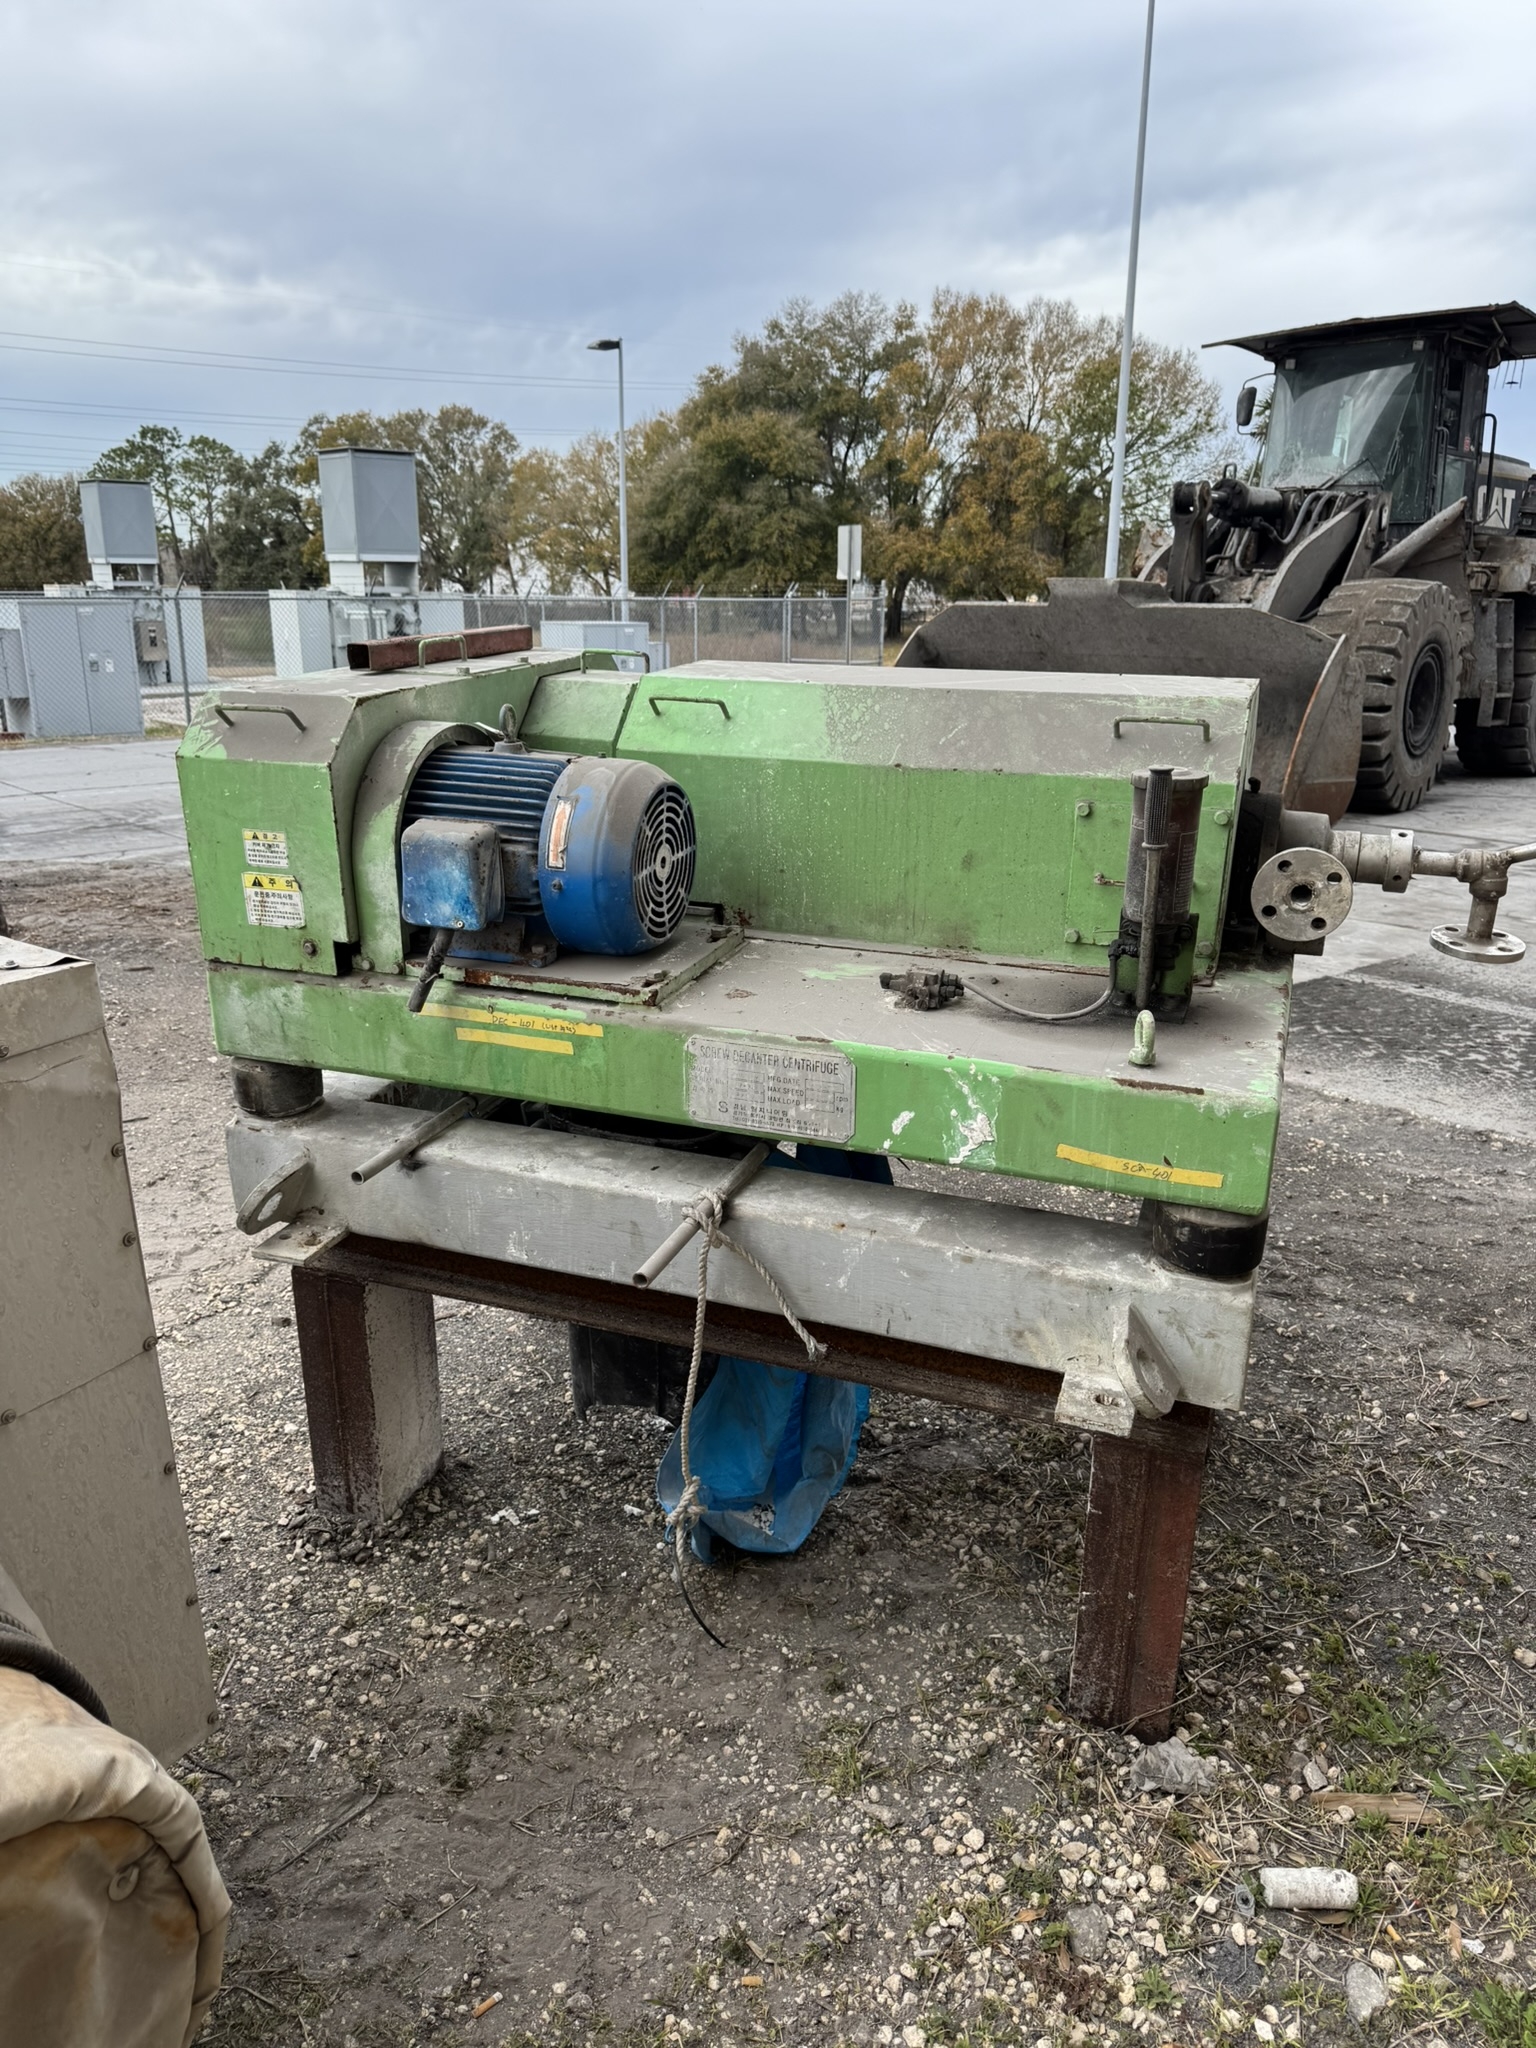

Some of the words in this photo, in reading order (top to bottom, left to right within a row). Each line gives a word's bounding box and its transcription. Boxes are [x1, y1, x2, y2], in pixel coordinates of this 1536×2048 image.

[1476, 485, 1516, 529] CAT
[700, 1045, 730, 1061] SCREW
[782, 1056, 840, 1076] CENTRIFUGE
